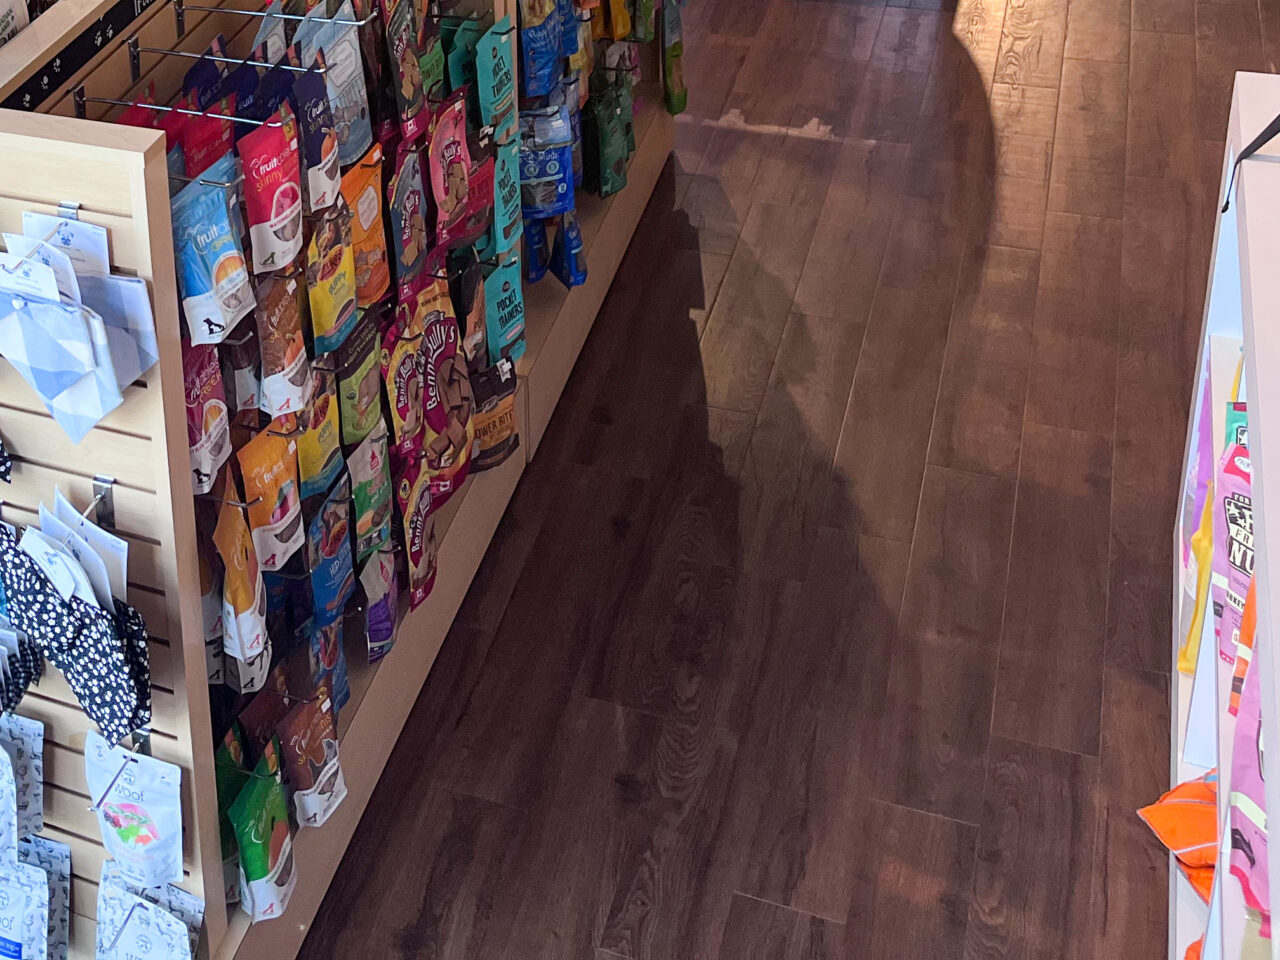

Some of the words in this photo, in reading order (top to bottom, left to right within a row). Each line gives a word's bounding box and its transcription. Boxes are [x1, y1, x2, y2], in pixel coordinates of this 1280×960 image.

[256, 169, 283, 192] skinny
[496, 288, 518, 314] POCKET
[498, 302, 524, 328] TRAINERS
[474, 420, 498, 440] OWER
[114, 783, 145, 802] woof
